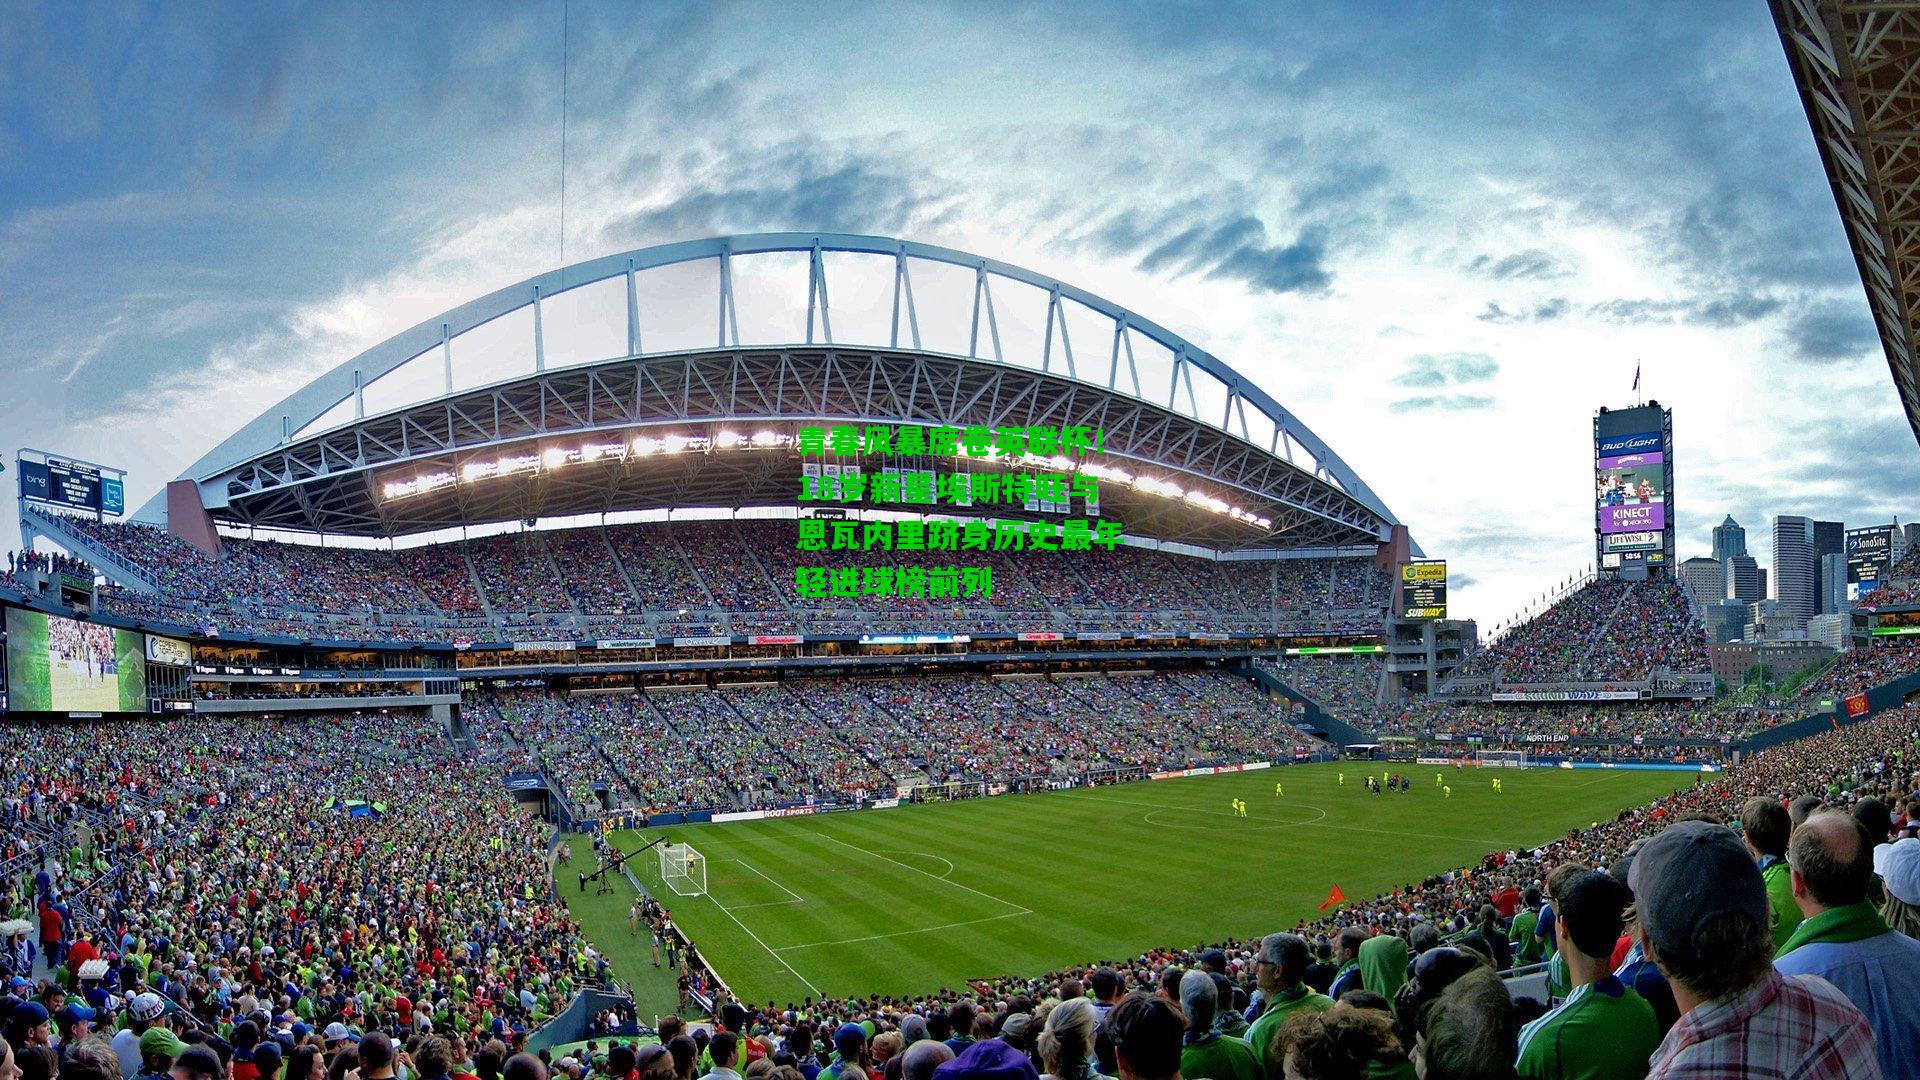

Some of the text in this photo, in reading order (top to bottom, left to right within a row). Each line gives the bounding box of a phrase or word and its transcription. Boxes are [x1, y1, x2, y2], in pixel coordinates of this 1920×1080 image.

[1628, 438, 1658, 447] LIGHT
[26, 474, 46, 488] bing
[1613, 506, 1653, 519] KINECT
[1858, 535, 1886, 548] SonoSite
[1416, 568, 1442, 577] Expedia
[1405, 607, 1445, 618] SUBWAY
[1553, 734, 1569, 742] END
[764, 808, 787, 818] ROOT
